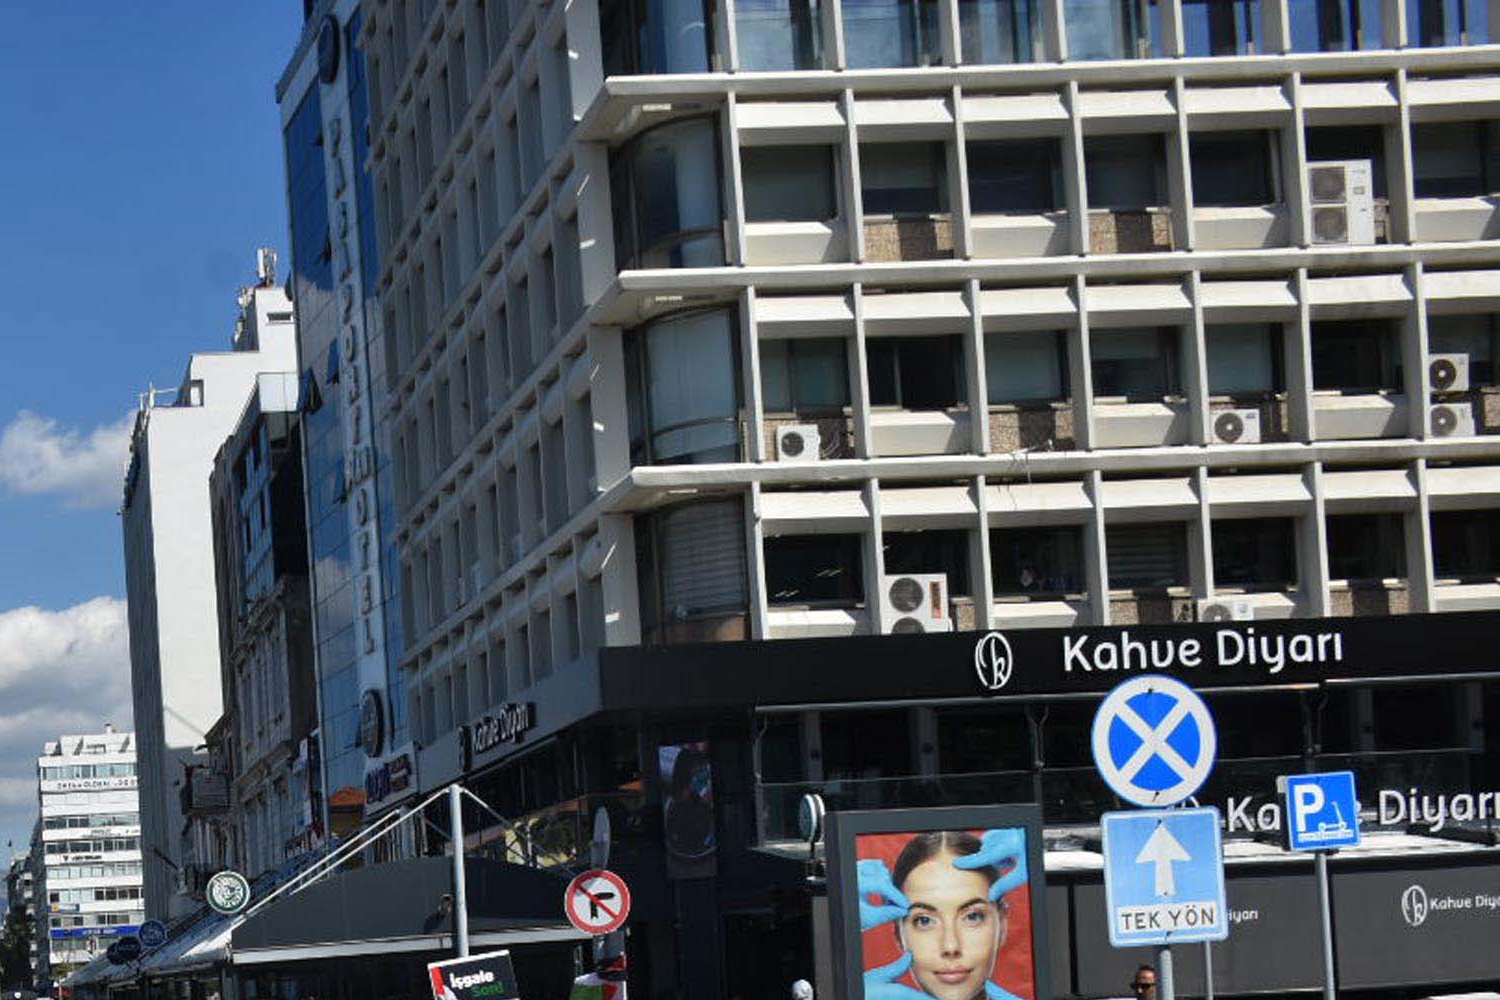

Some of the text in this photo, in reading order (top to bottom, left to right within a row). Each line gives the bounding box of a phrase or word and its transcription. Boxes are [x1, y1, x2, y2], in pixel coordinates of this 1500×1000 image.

[1217, 627, 1343, 673] Diyarı
[1293, 783, 1326, 833] P
[1121, 905, 1215, 930] TEK YÖN
